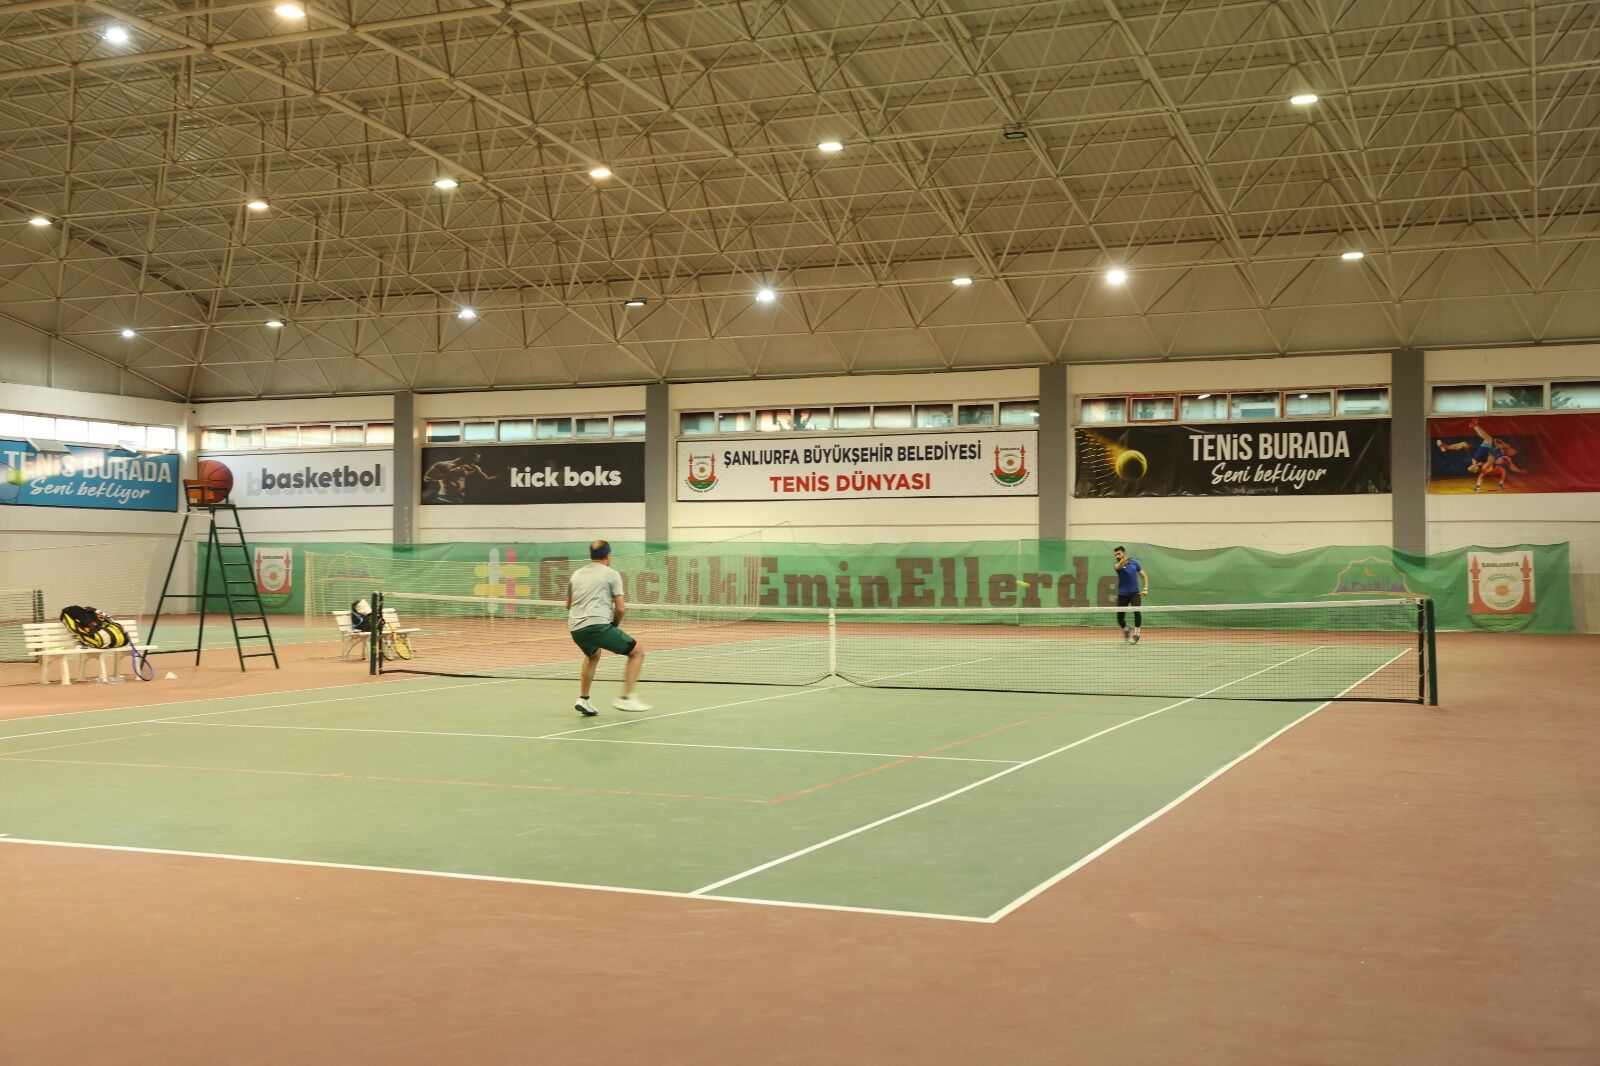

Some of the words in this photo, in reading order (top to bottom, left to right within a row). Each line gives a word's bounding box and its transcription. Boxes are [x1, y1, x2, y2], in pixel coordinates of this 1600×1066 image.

[724, 449, 800, 469] ŞANLIURFA
[804, 443, 894, 466] BÜYÜKŞEHİR
[898, 440, 982, 463] BELEDİYESİ
[1259, 430, 1351, 460] BURADA
[82, 454, 172, 484] BURADA
[261, 464, 381, 490] basketbol
[510, 466, 558, 488] kick
[564, 465, 622, 488] boks
[770, 471, 829, 494] TENİS
[836, 471, 932, 493] DÜNYASI
[1211, 462, 1251, 485] Seni
[1254, 465, 1327, 490] bekliyor
[30, 477, 74, 496] Seni
[77, 482, 151, 505] bekliyor
